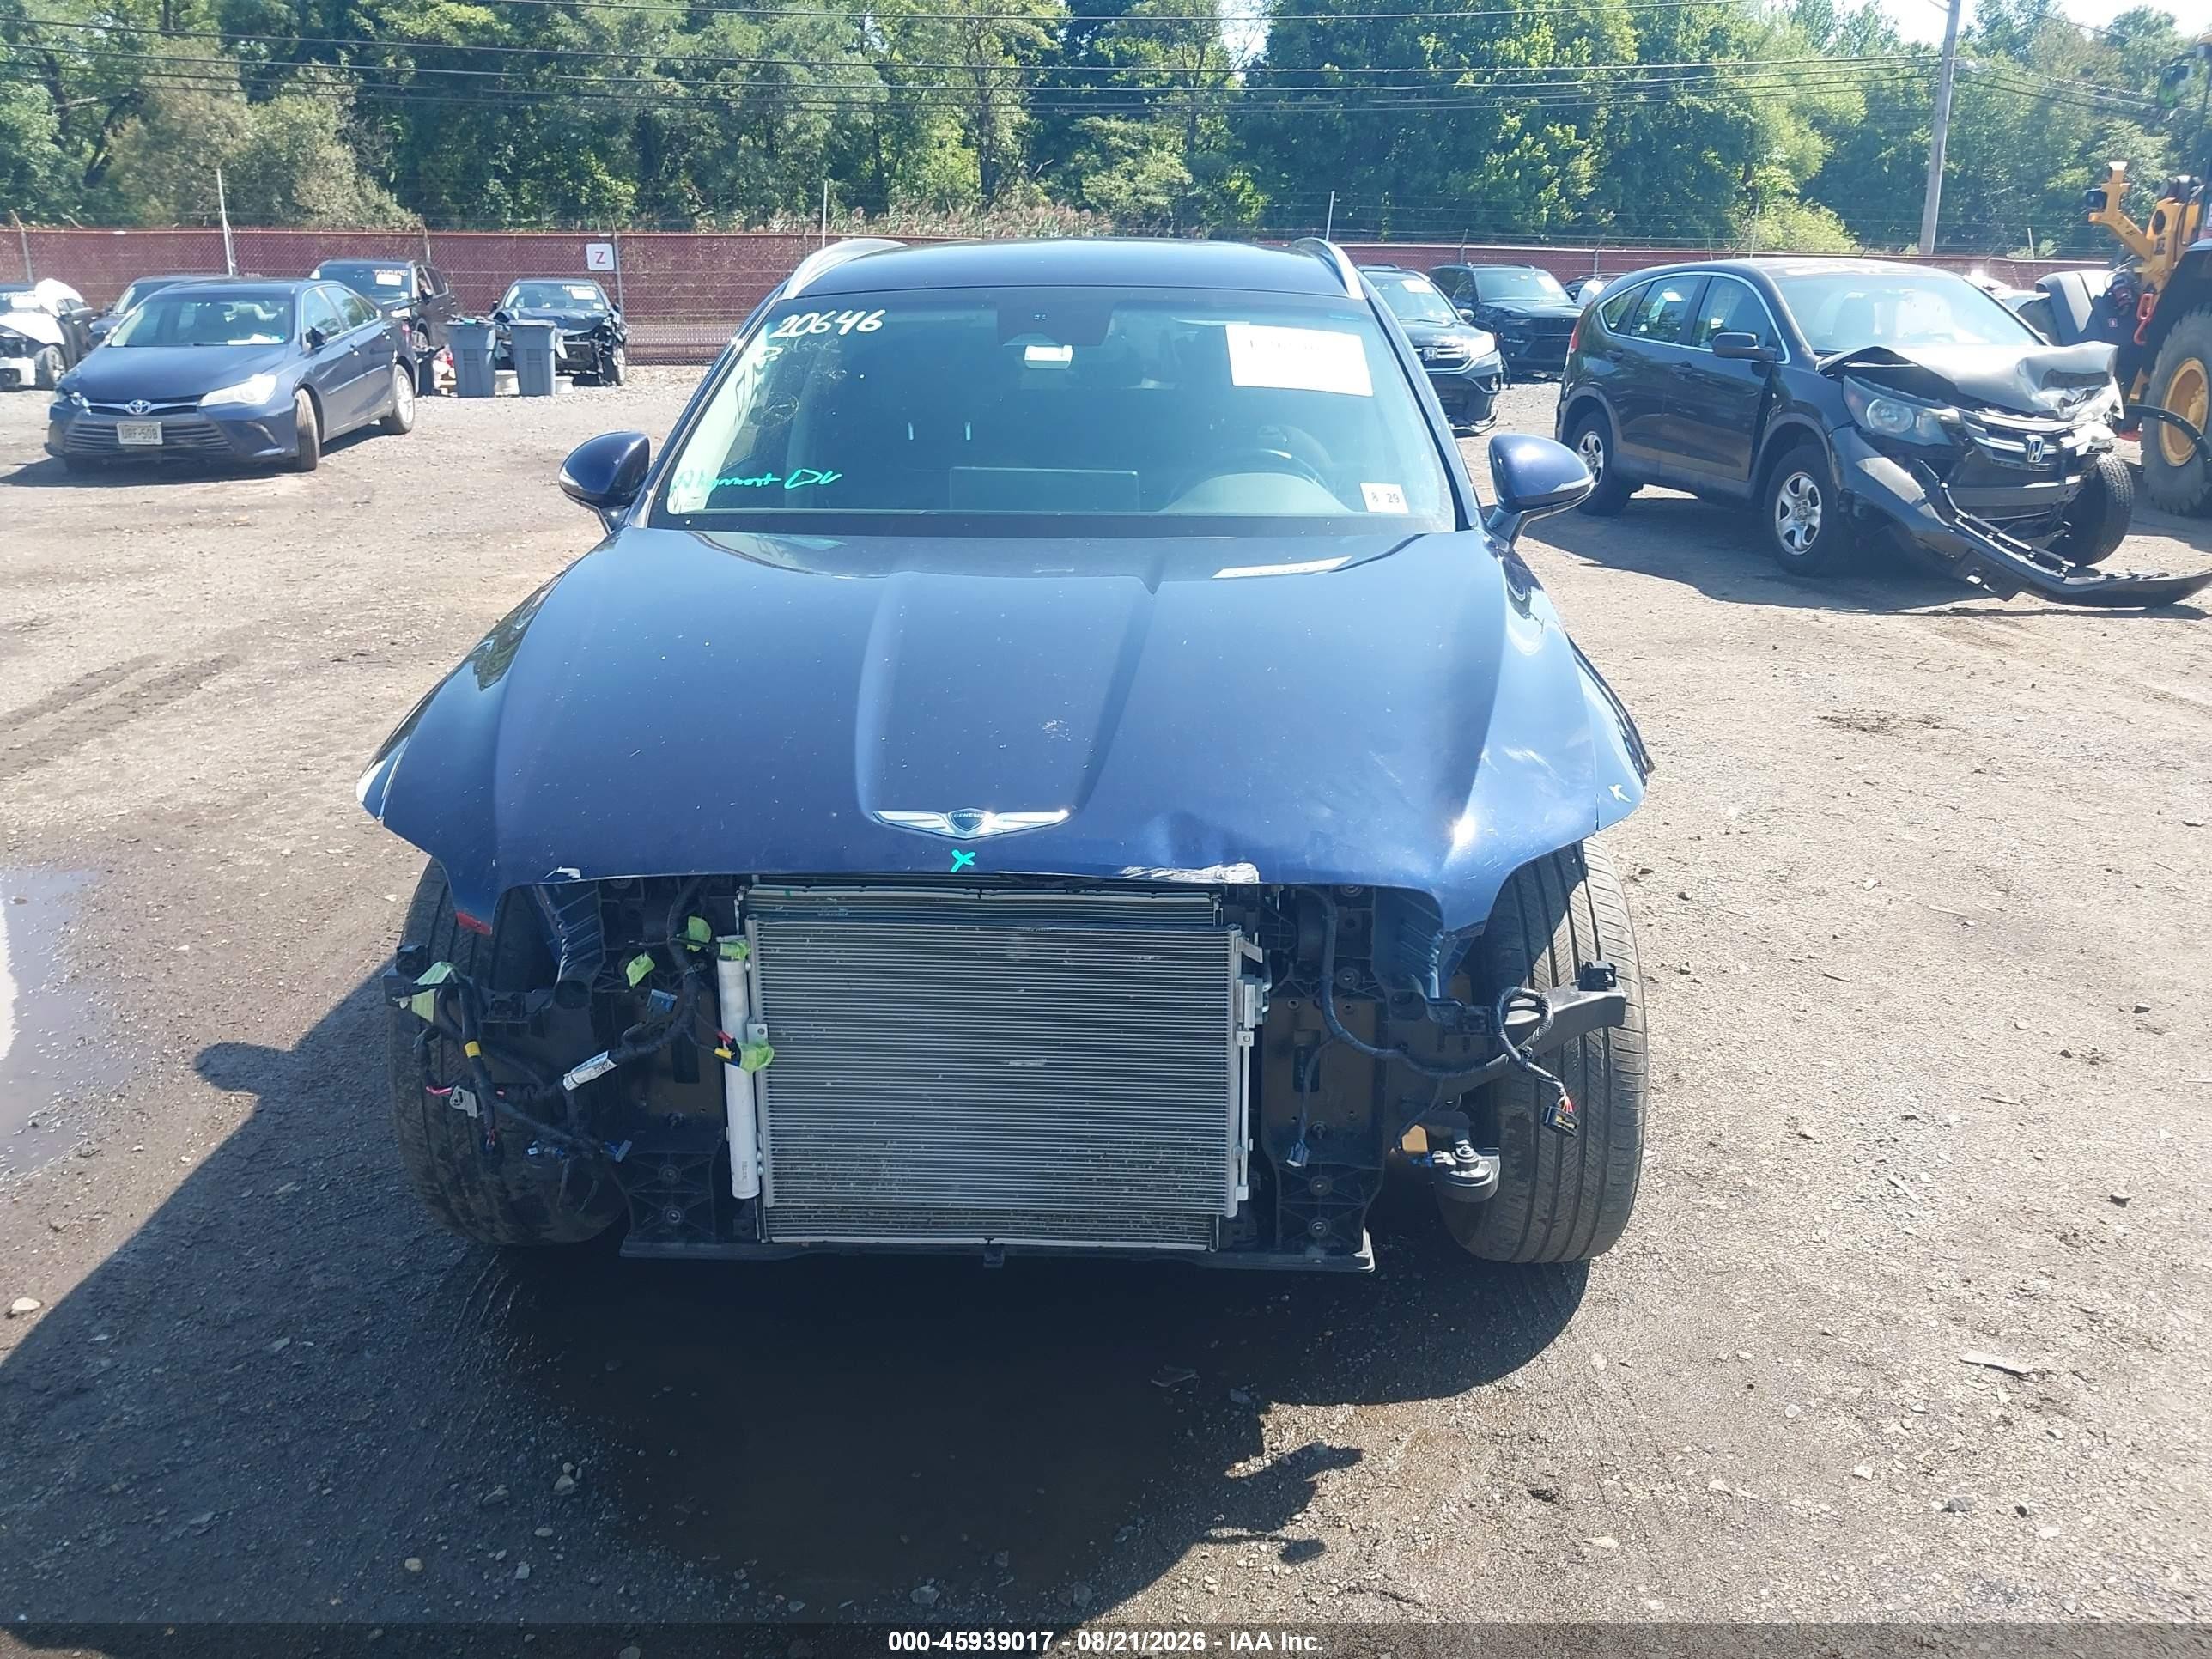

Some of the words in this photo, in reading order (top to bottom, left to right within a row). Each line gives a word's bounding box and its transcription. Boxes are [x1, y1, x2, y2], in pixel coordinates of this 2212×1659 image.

[594, 251, 606, 264] Z
[769, 309, 886, 338] 20646
[1386, 493, 1400, 503] 29
